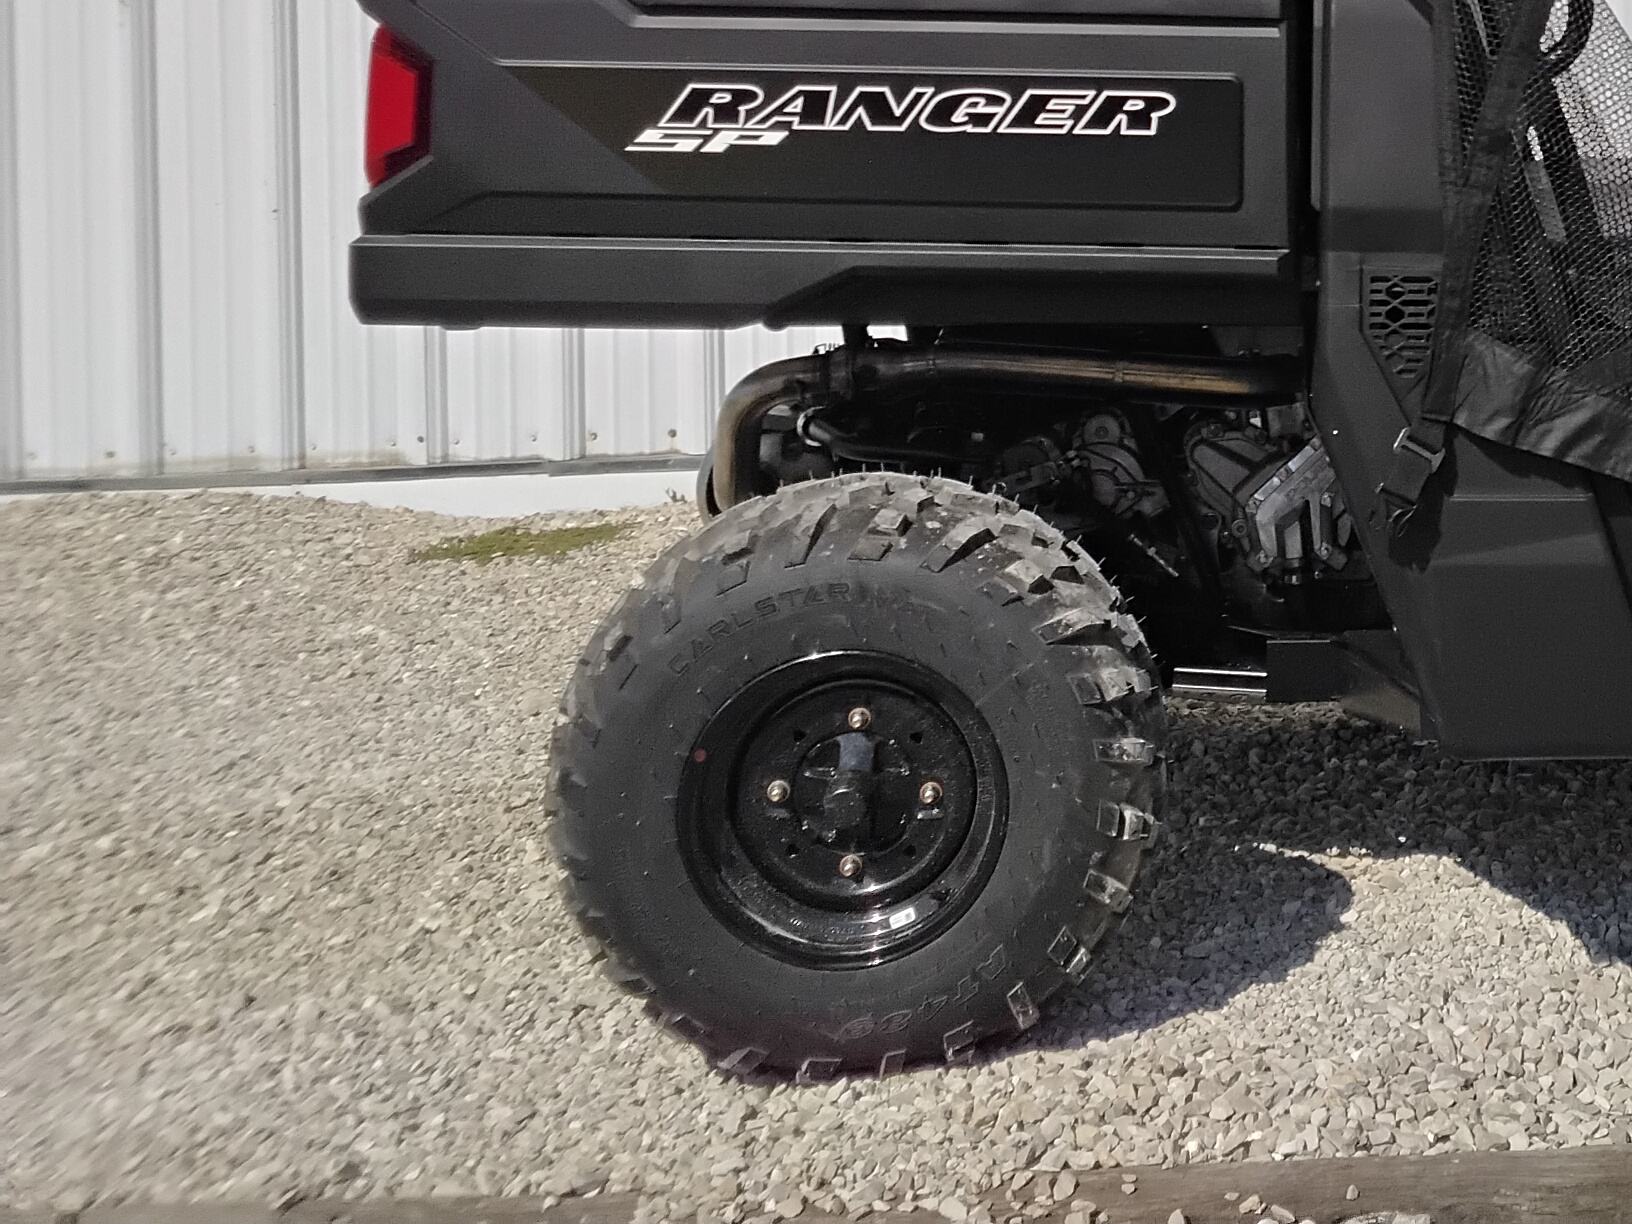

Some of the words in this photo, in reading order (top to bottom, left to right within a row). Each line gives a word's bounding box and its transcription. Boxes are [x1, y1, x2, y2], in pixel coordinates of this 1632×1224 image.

[660, 83, 1176, 135] RANGER
[625, 128, 792, 153] SP
[666, 580, 852, 678] CARLSTAR
